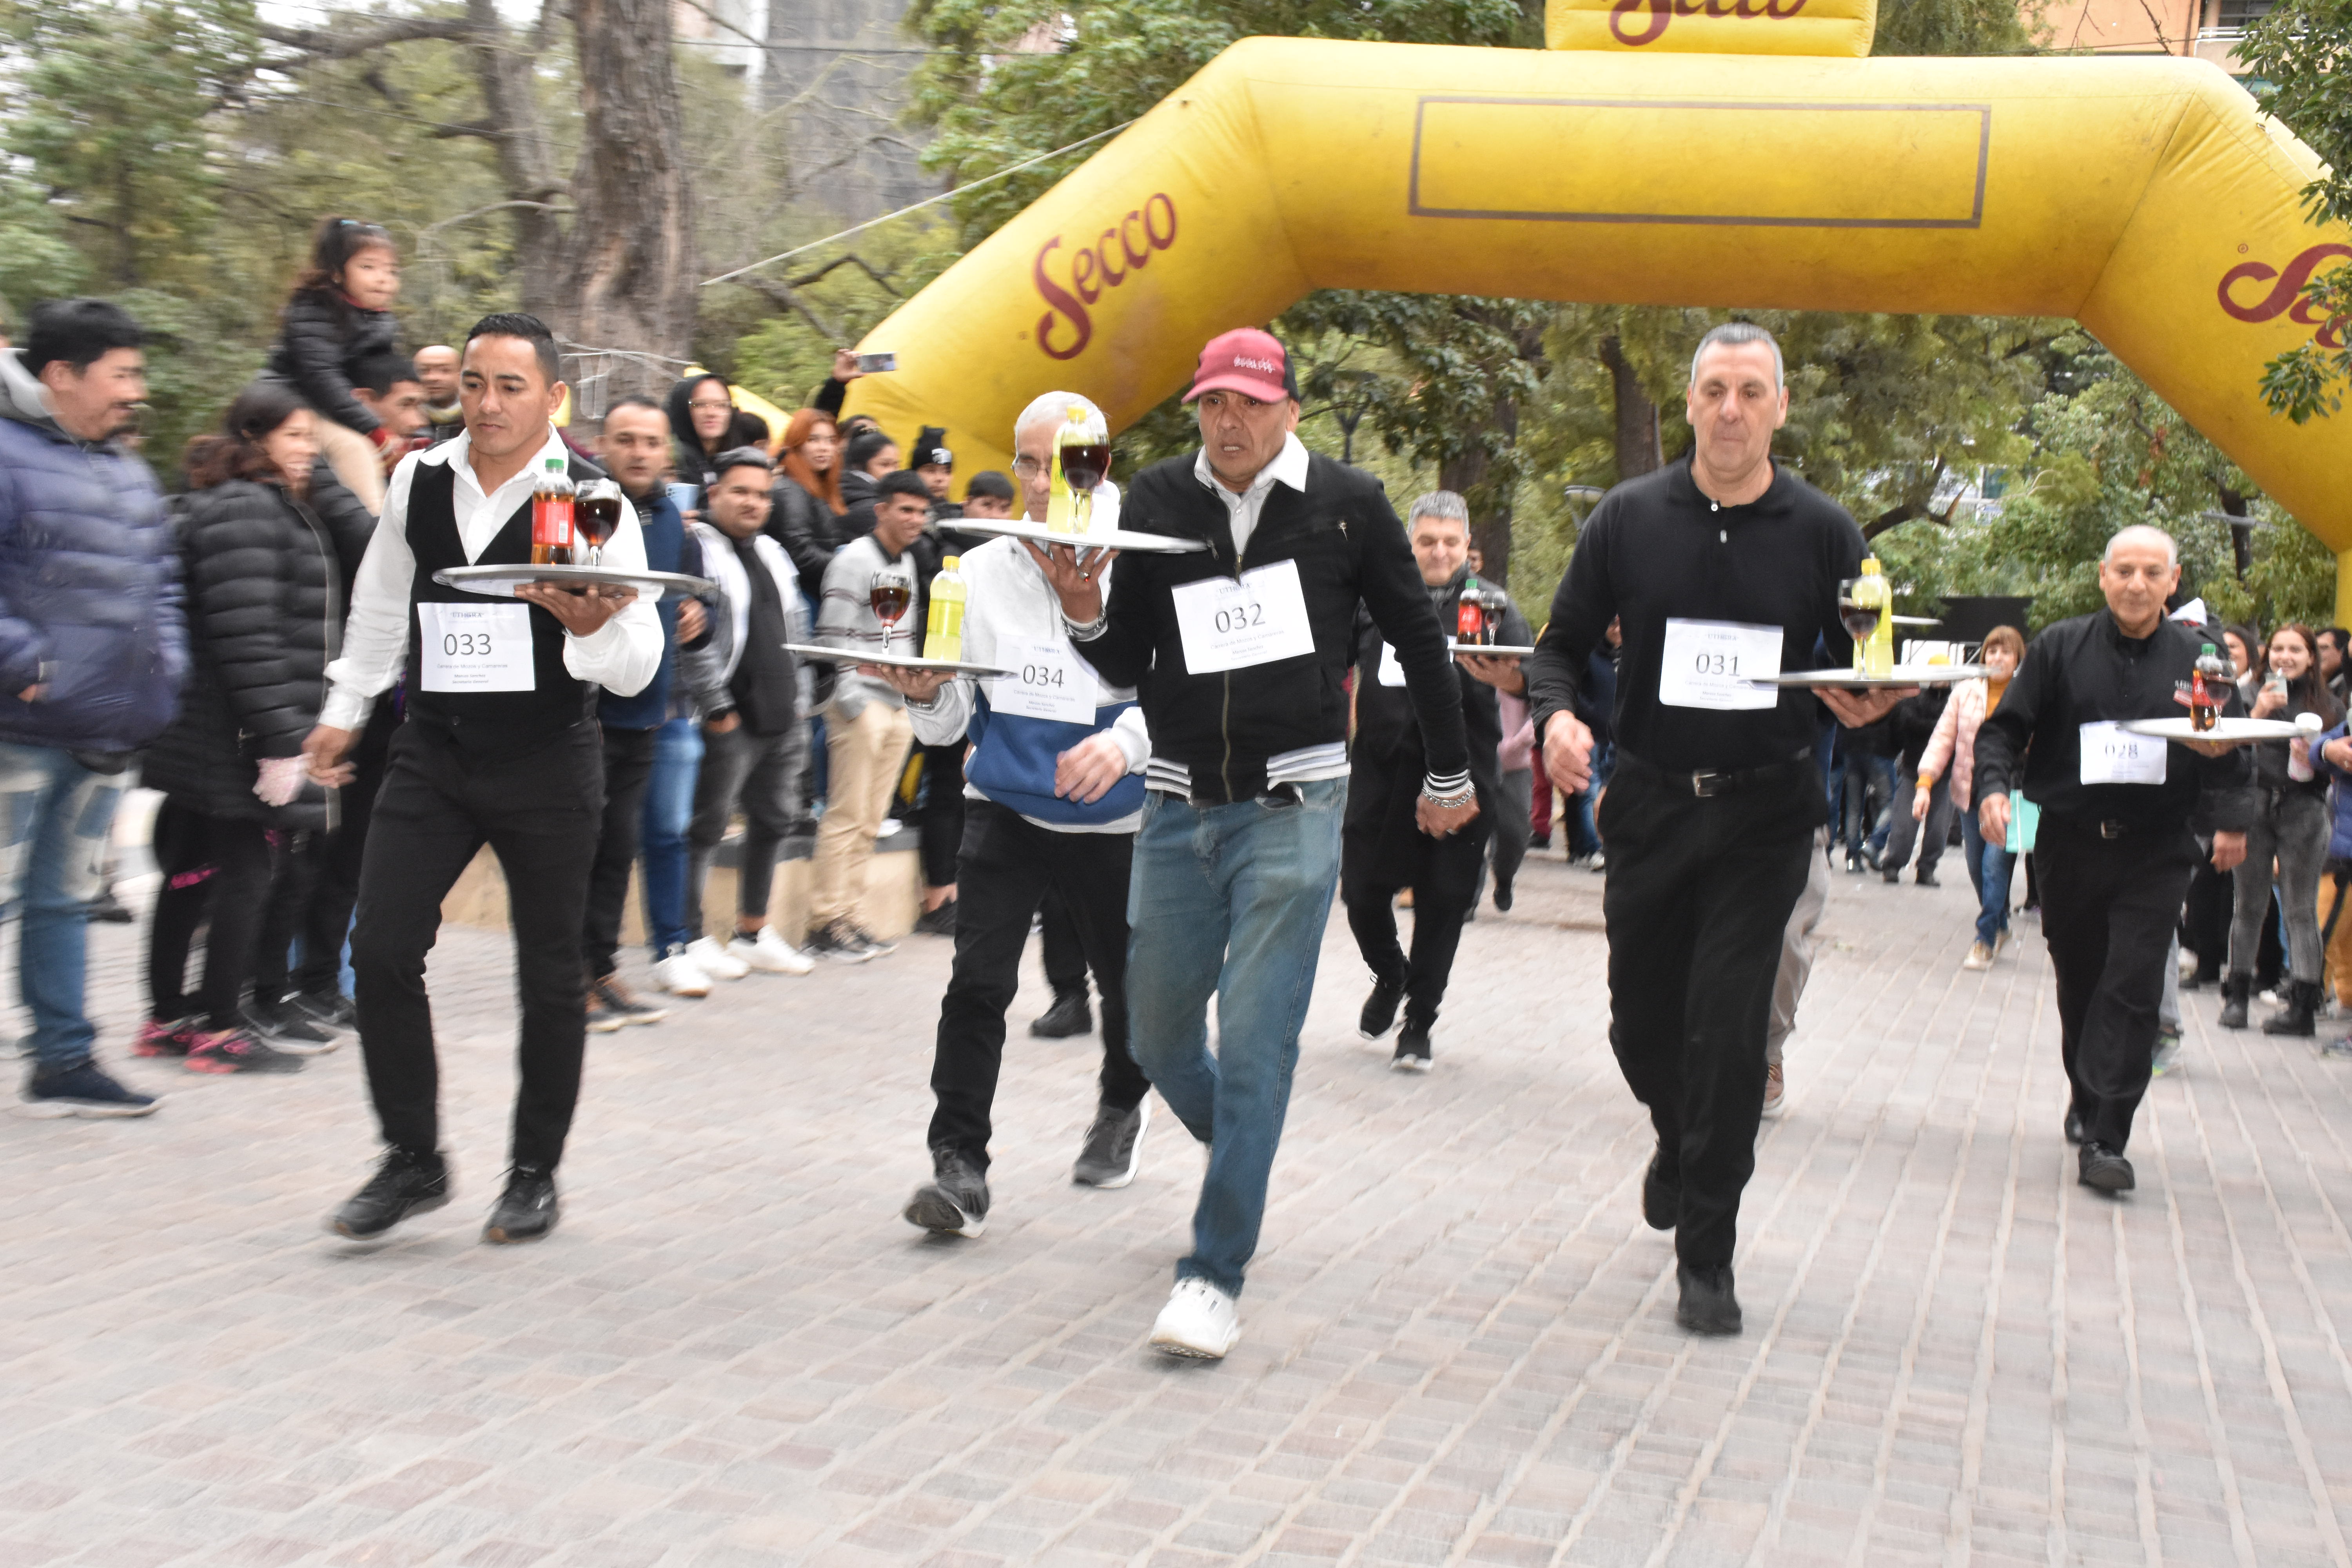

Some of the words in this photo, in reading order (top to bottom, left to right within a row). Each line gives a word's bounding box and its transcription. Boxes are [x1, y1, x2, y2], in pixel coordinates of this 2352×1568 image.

[1032, 192, 1176, 360] Secco
[1215, 603, 1266, 633] 032
[444, 633, 492, 656] 033
[1258, 630, 1284, 639] Camareras
[1023, 665, 1064, 688] 034
[1696, 653, 1740, 677] 031
[2105, 740, 2138, 759] 028
